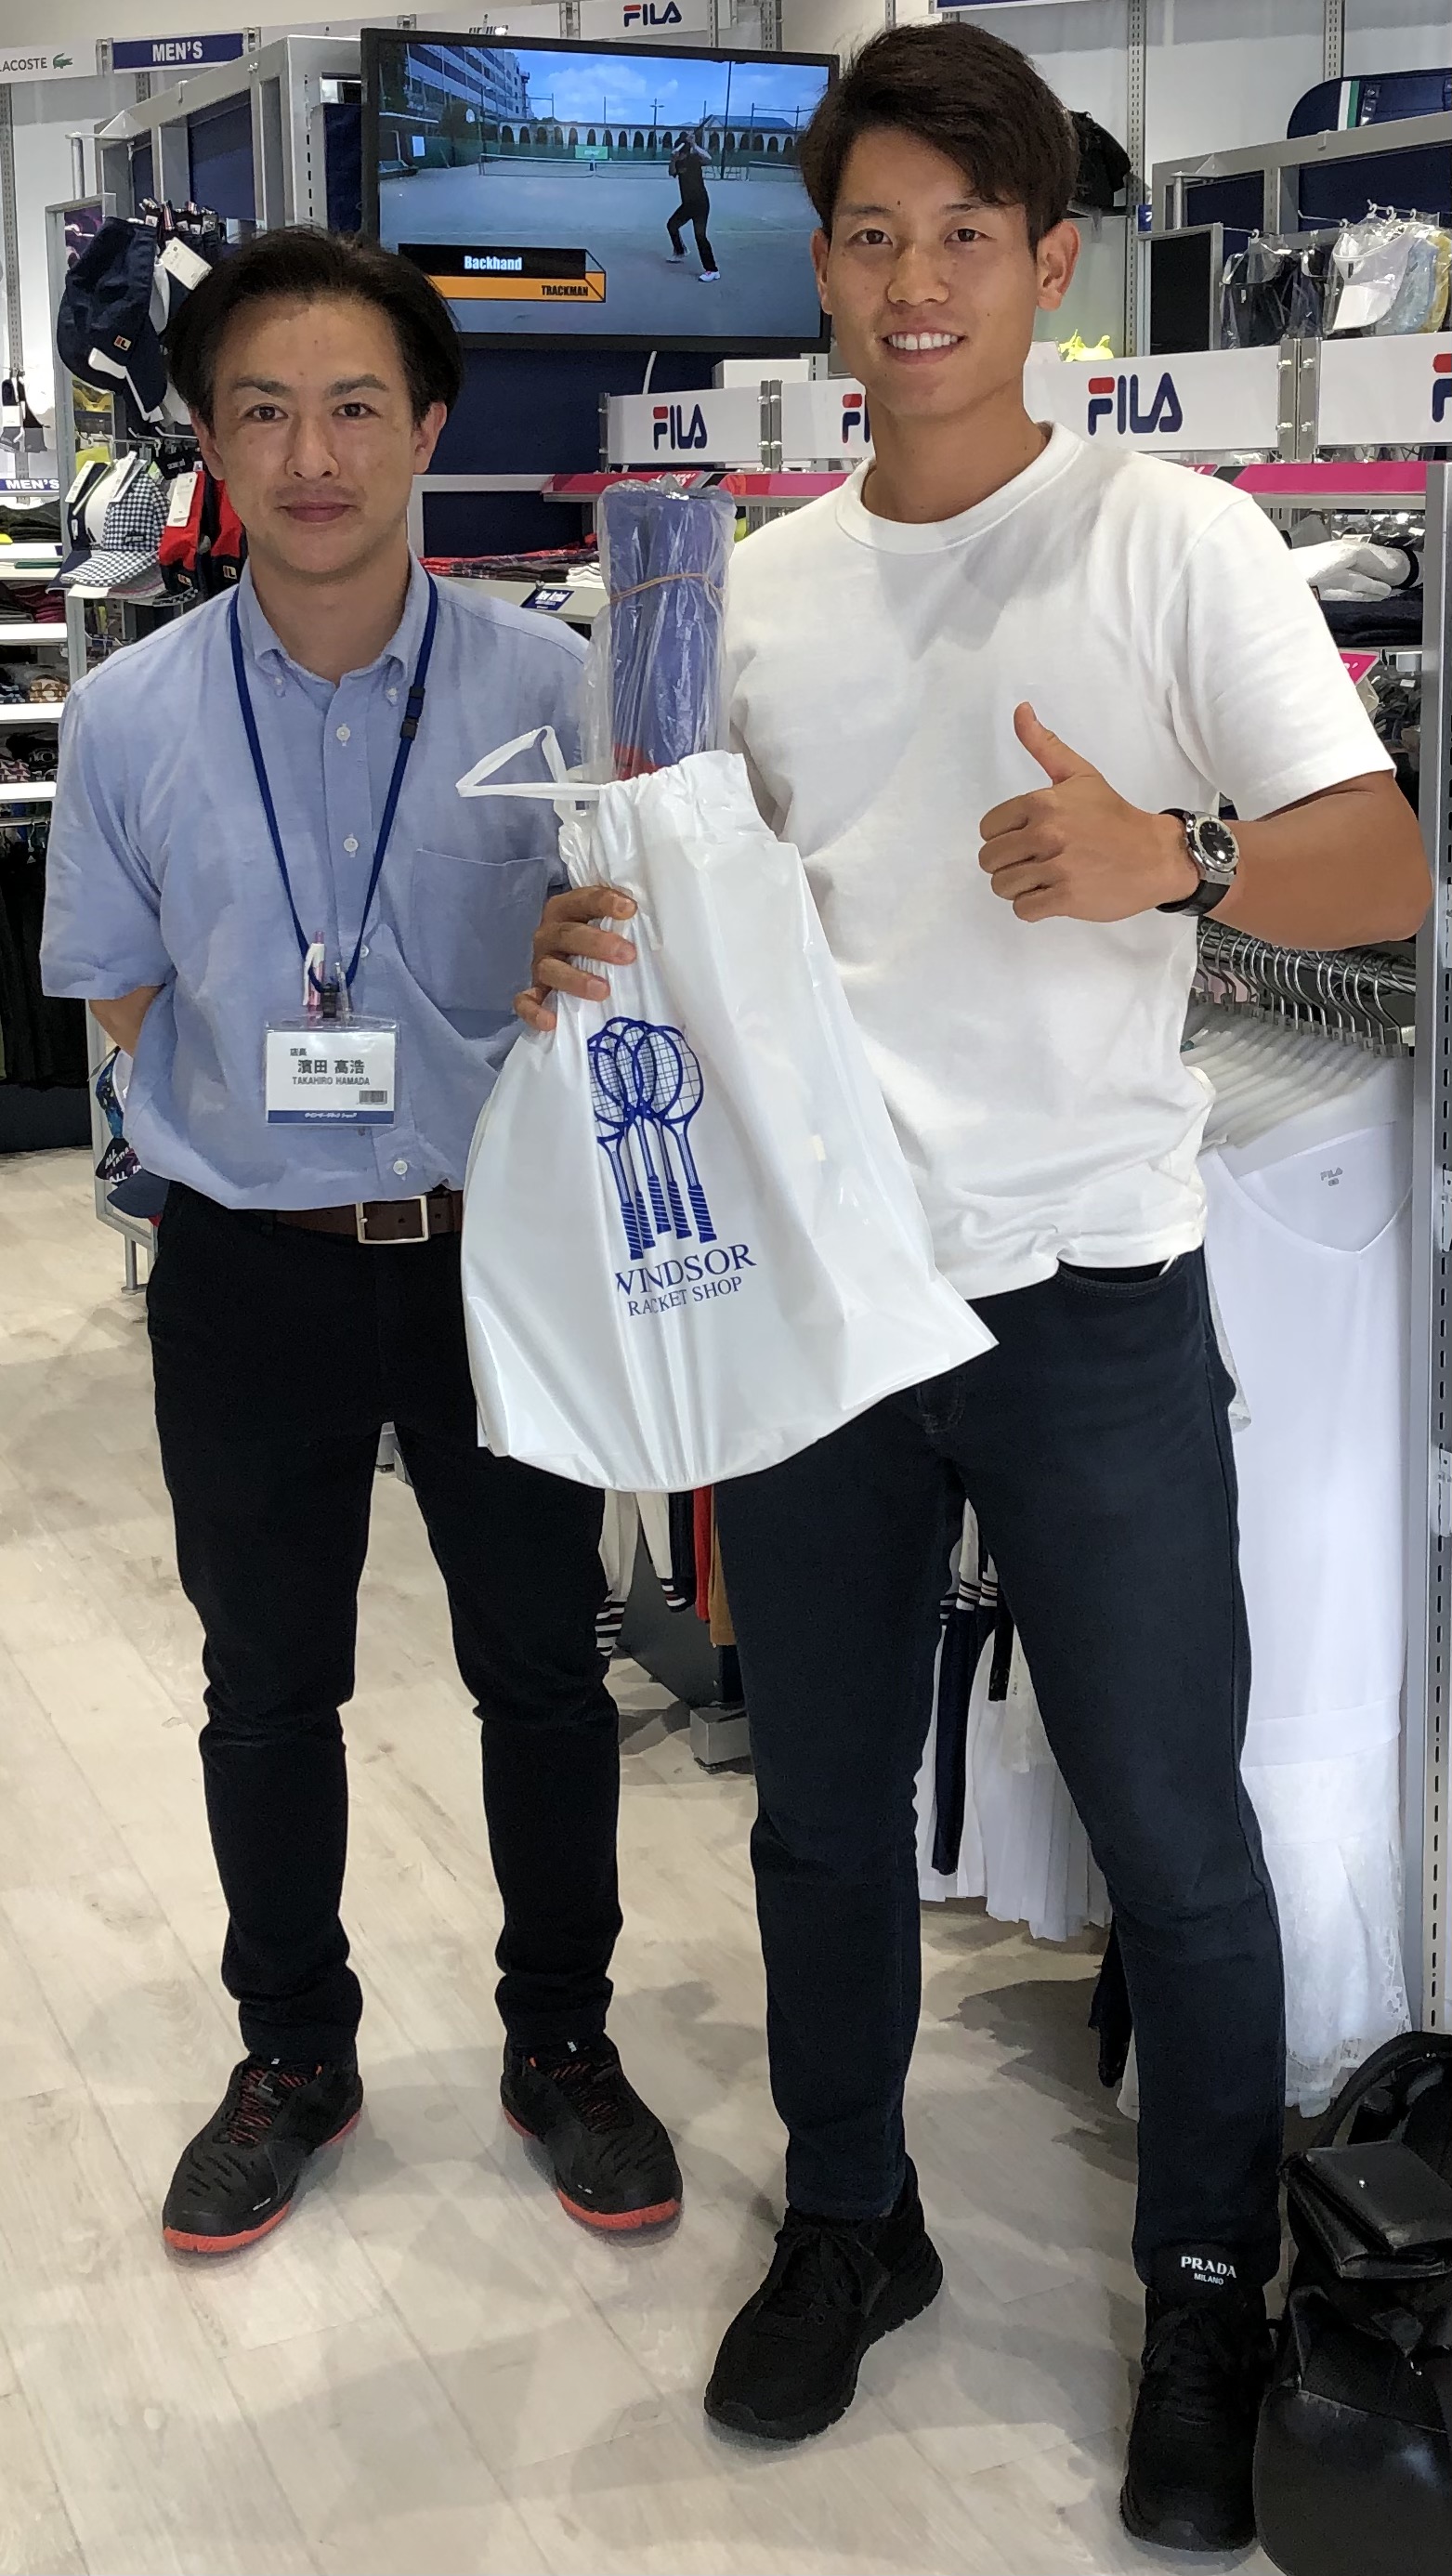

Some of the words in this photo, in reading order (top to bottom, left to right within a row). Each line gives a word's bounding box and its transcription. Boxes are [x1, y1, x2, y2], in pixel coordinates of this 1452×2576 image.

[623, 1, 682, 27] FILA
[152, 41, 203, 62] MEN'S
[464, 255, 522, 270] Backhand
[542, 284, 589, 296] TRACKMAN
[1088, 372, 1184, 436] FILA
[653, 403, 708, 451] FILA
[6, 479, 59, 490] MEN'S
[293, 1076, 334, 1085] TAKAHIRO
[335, 1077, 370, 1086] HAMADA
[627, 1288, 687, 1317] RACKET
[691, 1275, 742, 1302] SHOP
[1180, 2256, 1237, 2279] PRADA
[1194, 2272, 1224, 2285] MILANO
